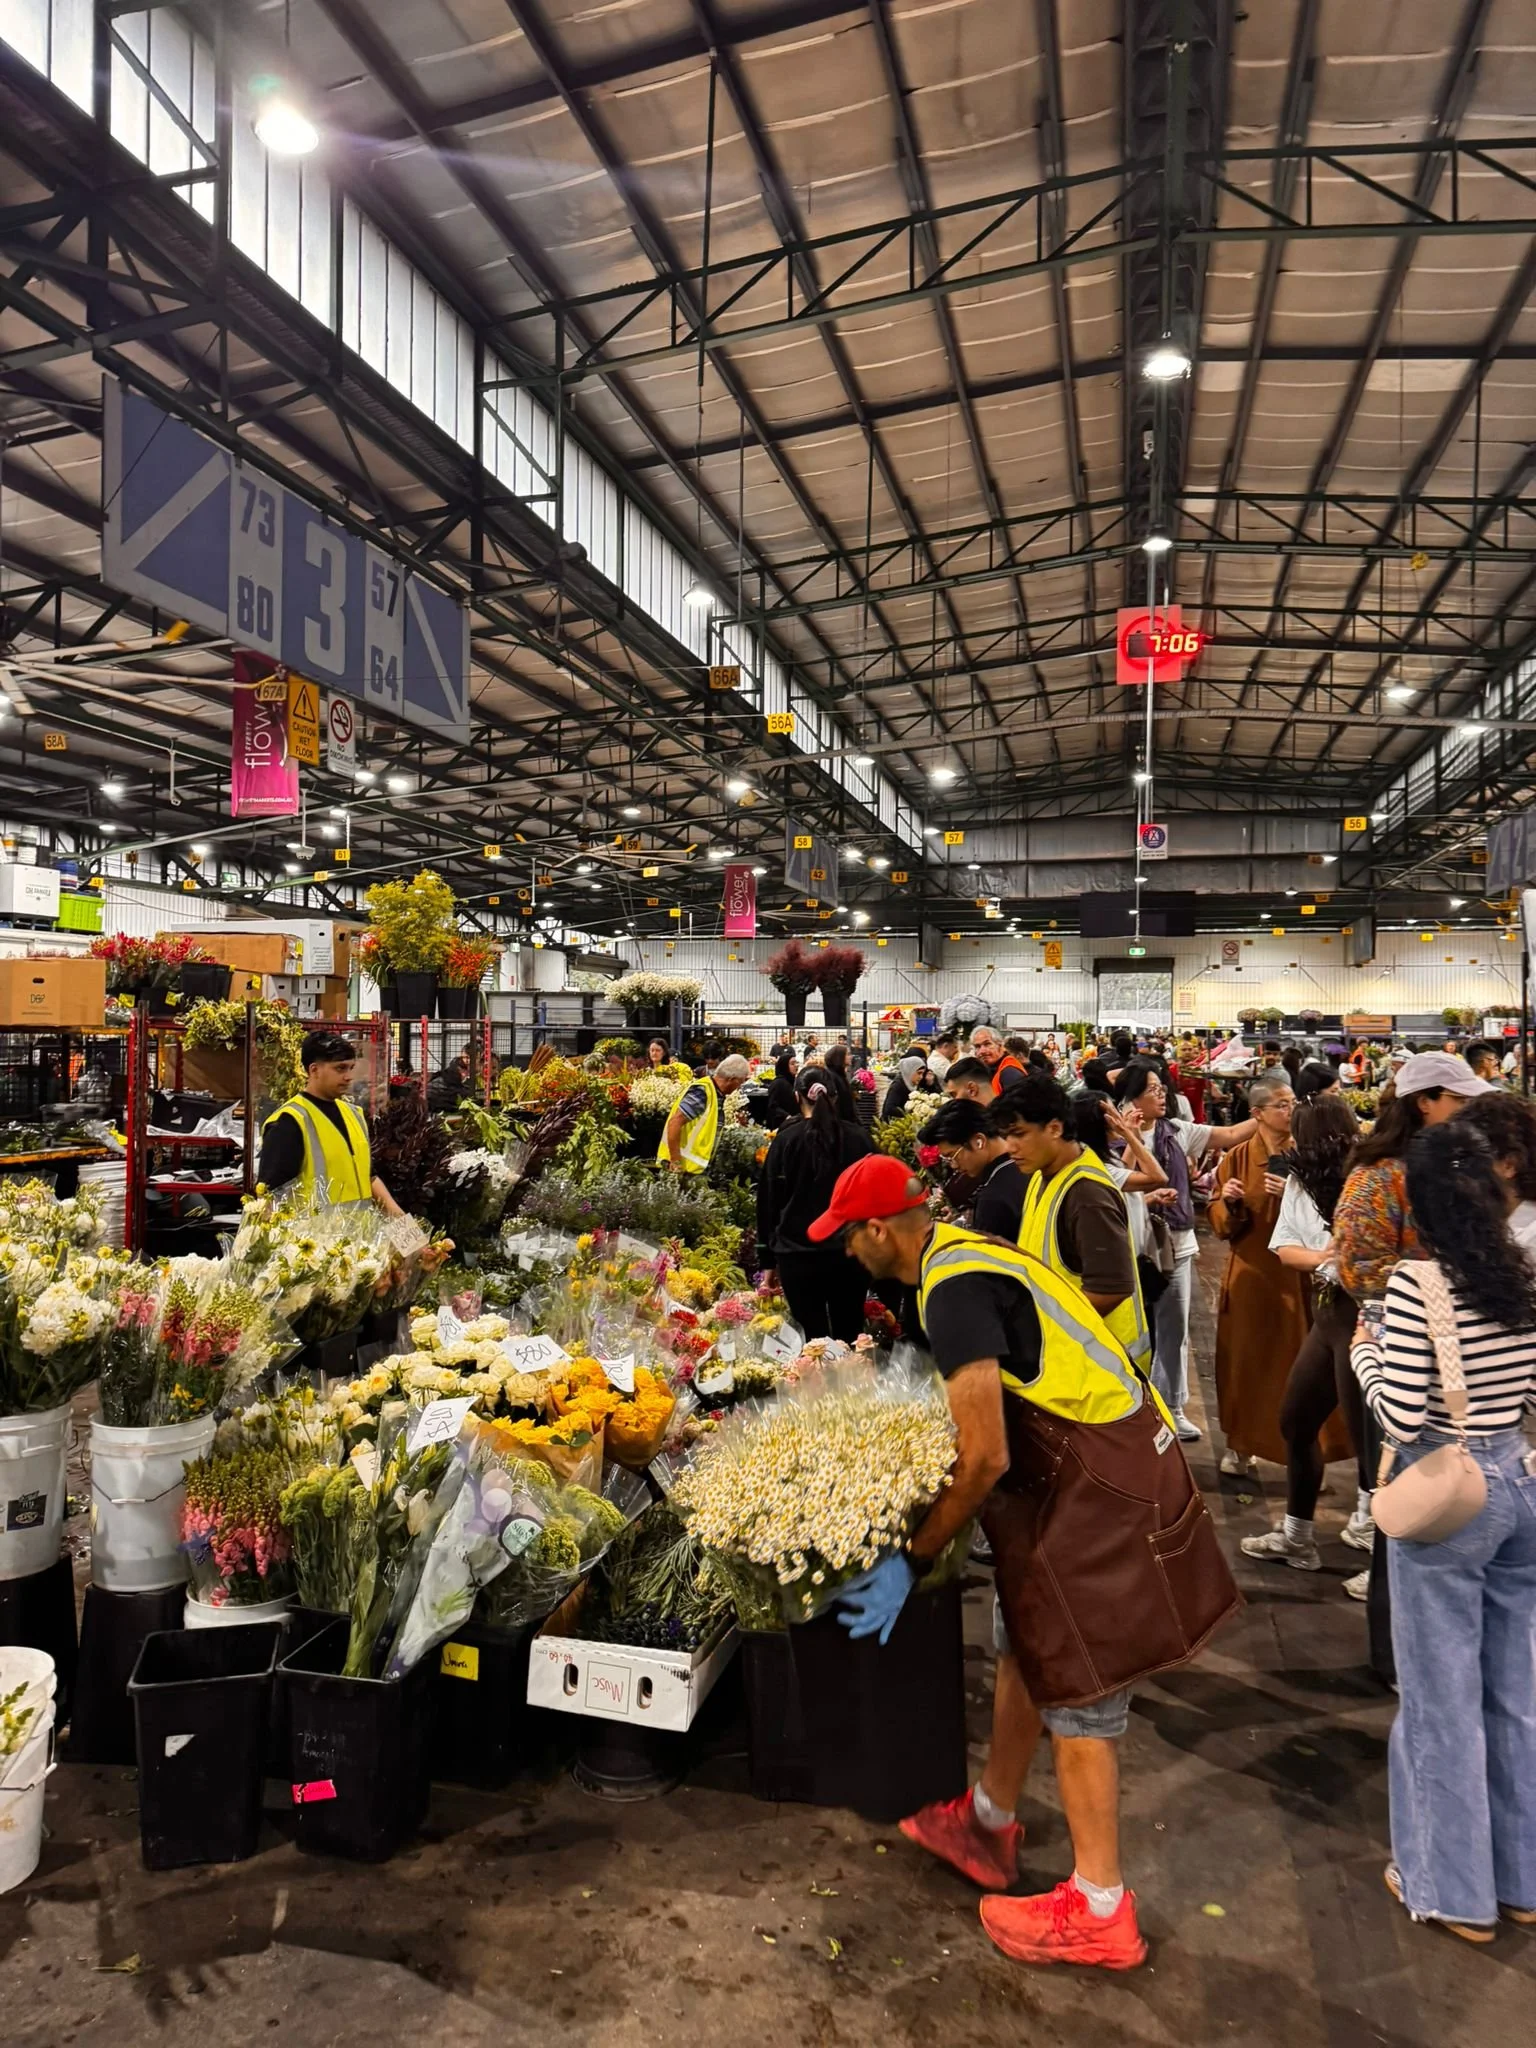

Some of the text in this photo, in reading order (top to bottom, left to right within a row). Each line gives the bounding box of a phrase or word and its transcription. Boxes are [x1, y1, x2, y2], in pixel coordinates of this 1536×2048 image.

[239, 477, 276, 548] 73
[371, 560, 399, 618] 57
[304, 520, 347, 676] 3
[237, 575, 274, 643] 80
[1150, 633, 1198, 653] 7:06
[370, 644, 399, 702] 64
[714, 669, 739, 685] 66A
[263, 685, 283, 699] 67A
[292, 721, 317, 737] CAUTION
[771, 715, 793, 730] 56A
[46, 735, 65, 748] 58A
[244, 703, 272, 769] flow
[295, 745, 313, 759] FLOOR
[337, 744, 345, 753] NO
[1350, 818, 1361, 829] 56
[797, 838, 808, 847] 58
[948, 833, 960, 843] 57
[729, 873, 744, 918] flower
[514, 1343, 552, 1365] $80
